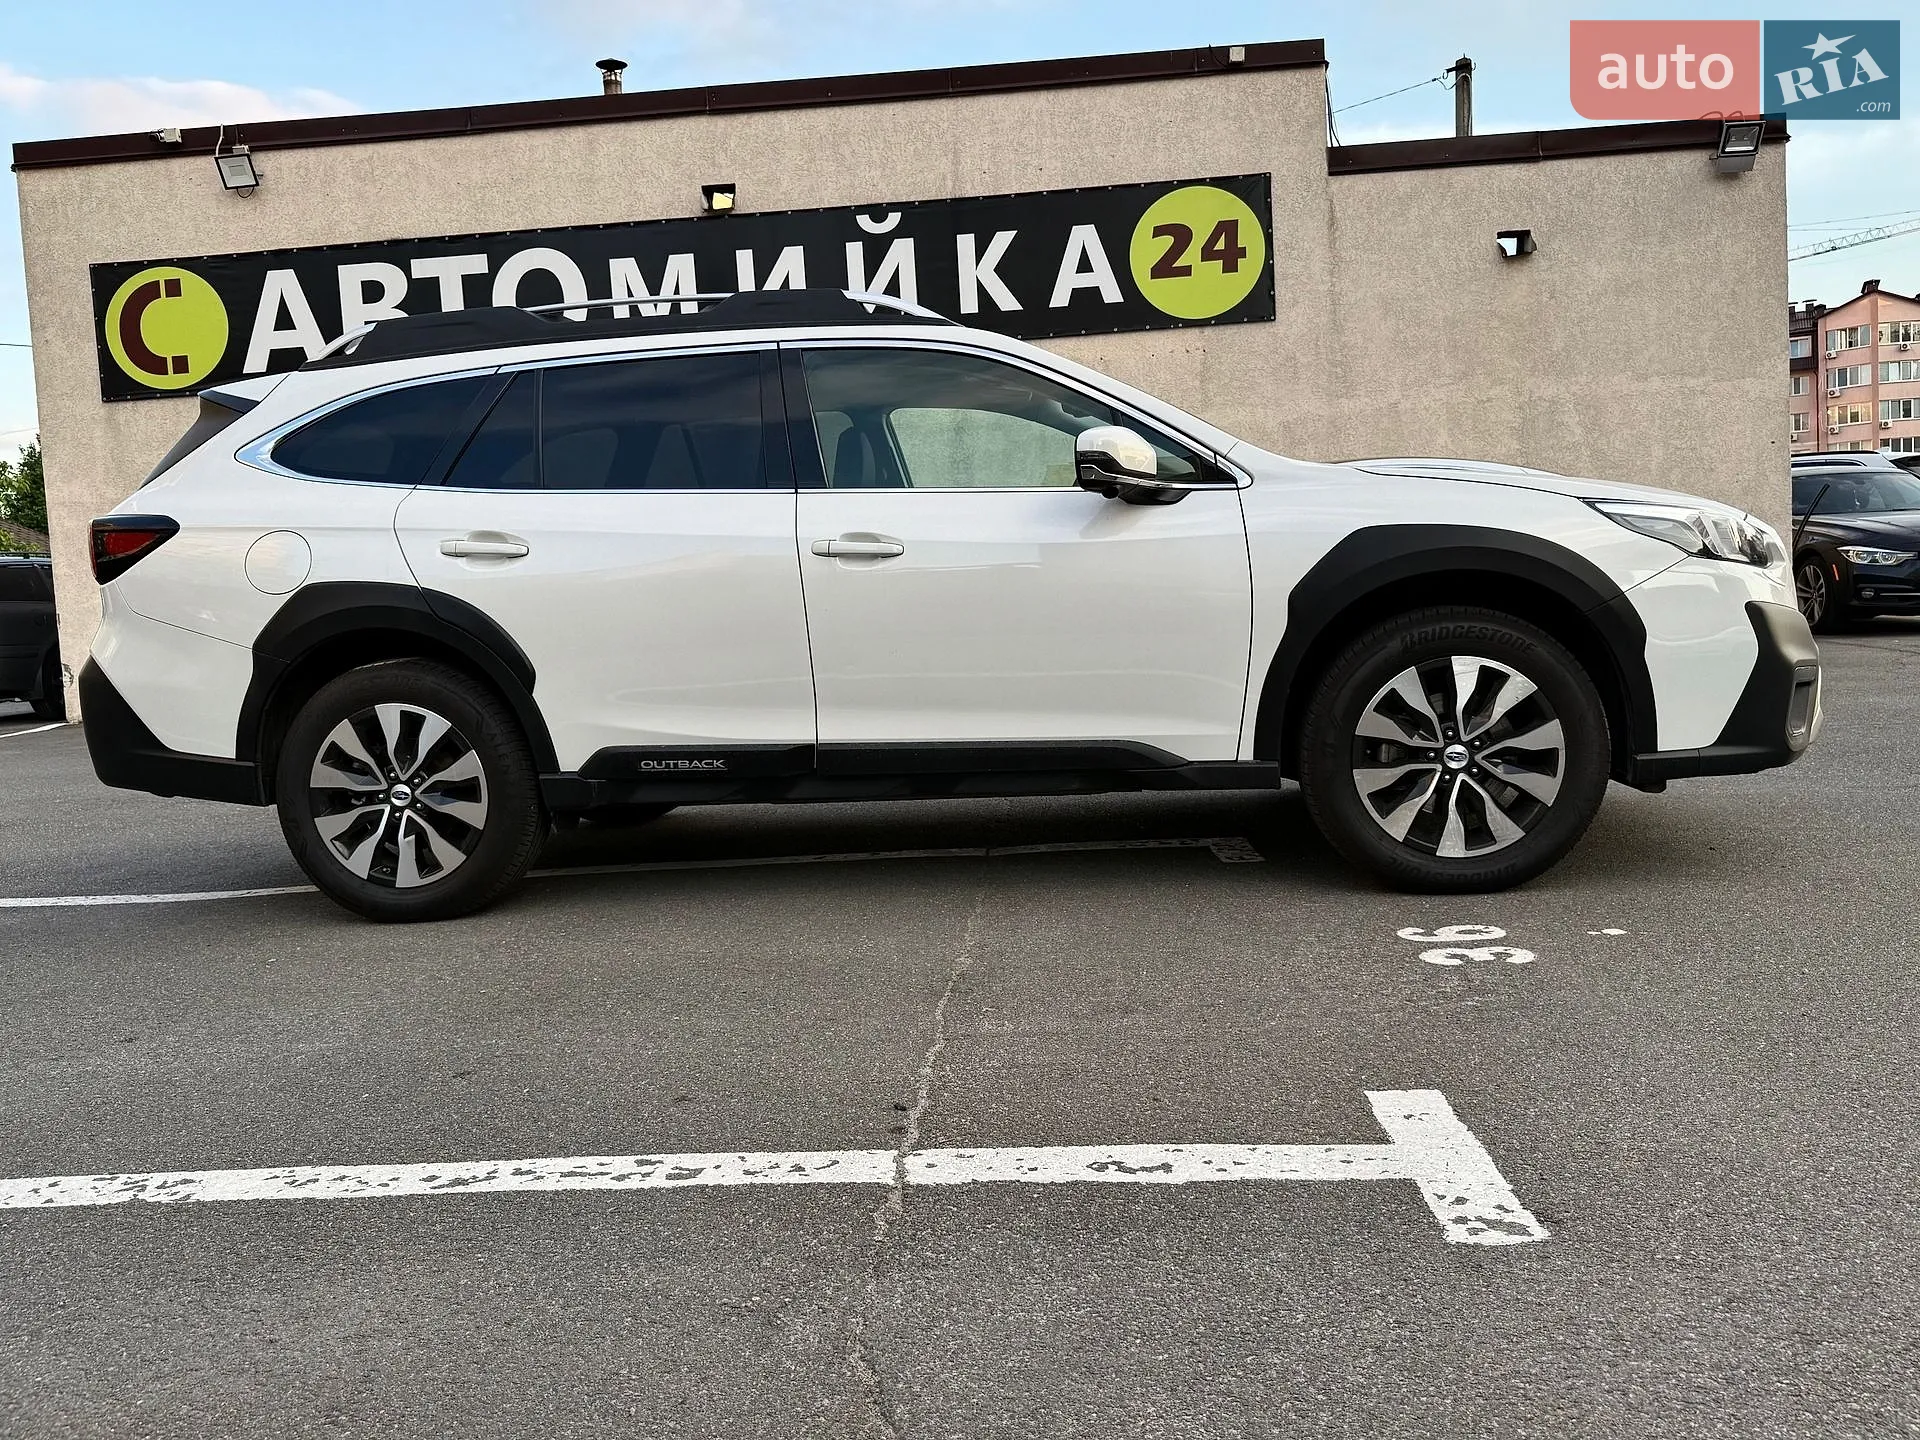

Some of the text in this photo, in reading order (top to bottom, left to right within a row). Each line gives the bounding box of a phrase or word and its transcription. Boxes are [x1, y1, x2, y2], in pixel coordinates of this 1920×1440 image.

[242, 211, 1124, 374] АВТОМИЙКА
[1149, 218, 1247, 280] 24
[640, 759, 727, 769] OUTBACK
[1397, 924, 1536, 966] 36
